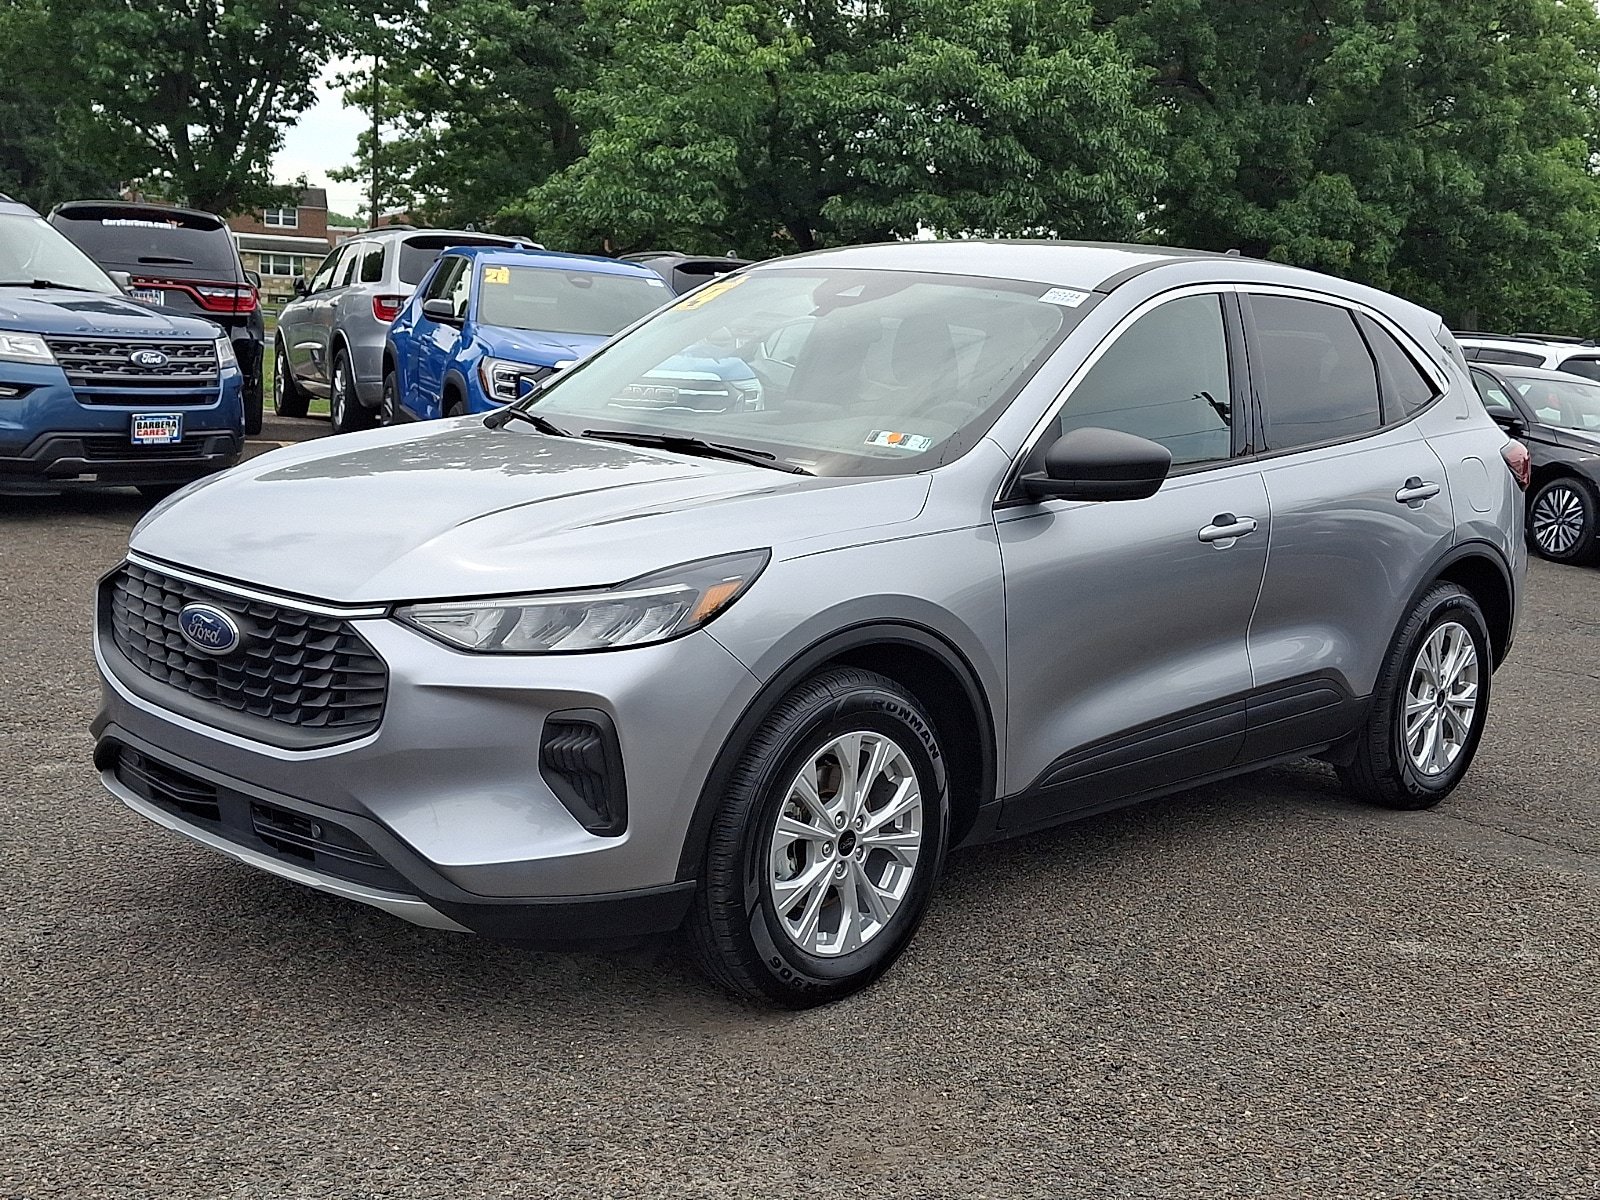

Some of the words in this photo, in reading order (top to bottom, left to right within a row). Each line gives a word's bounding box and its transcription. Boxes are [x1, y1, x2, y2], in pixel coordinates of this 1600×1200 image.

[141, 353, 162, 364] Ford
[136, 421, 177, 430] BARBERA
[136, 429, 167, 437] CARES
[188, 613, 222, 645] Ford
